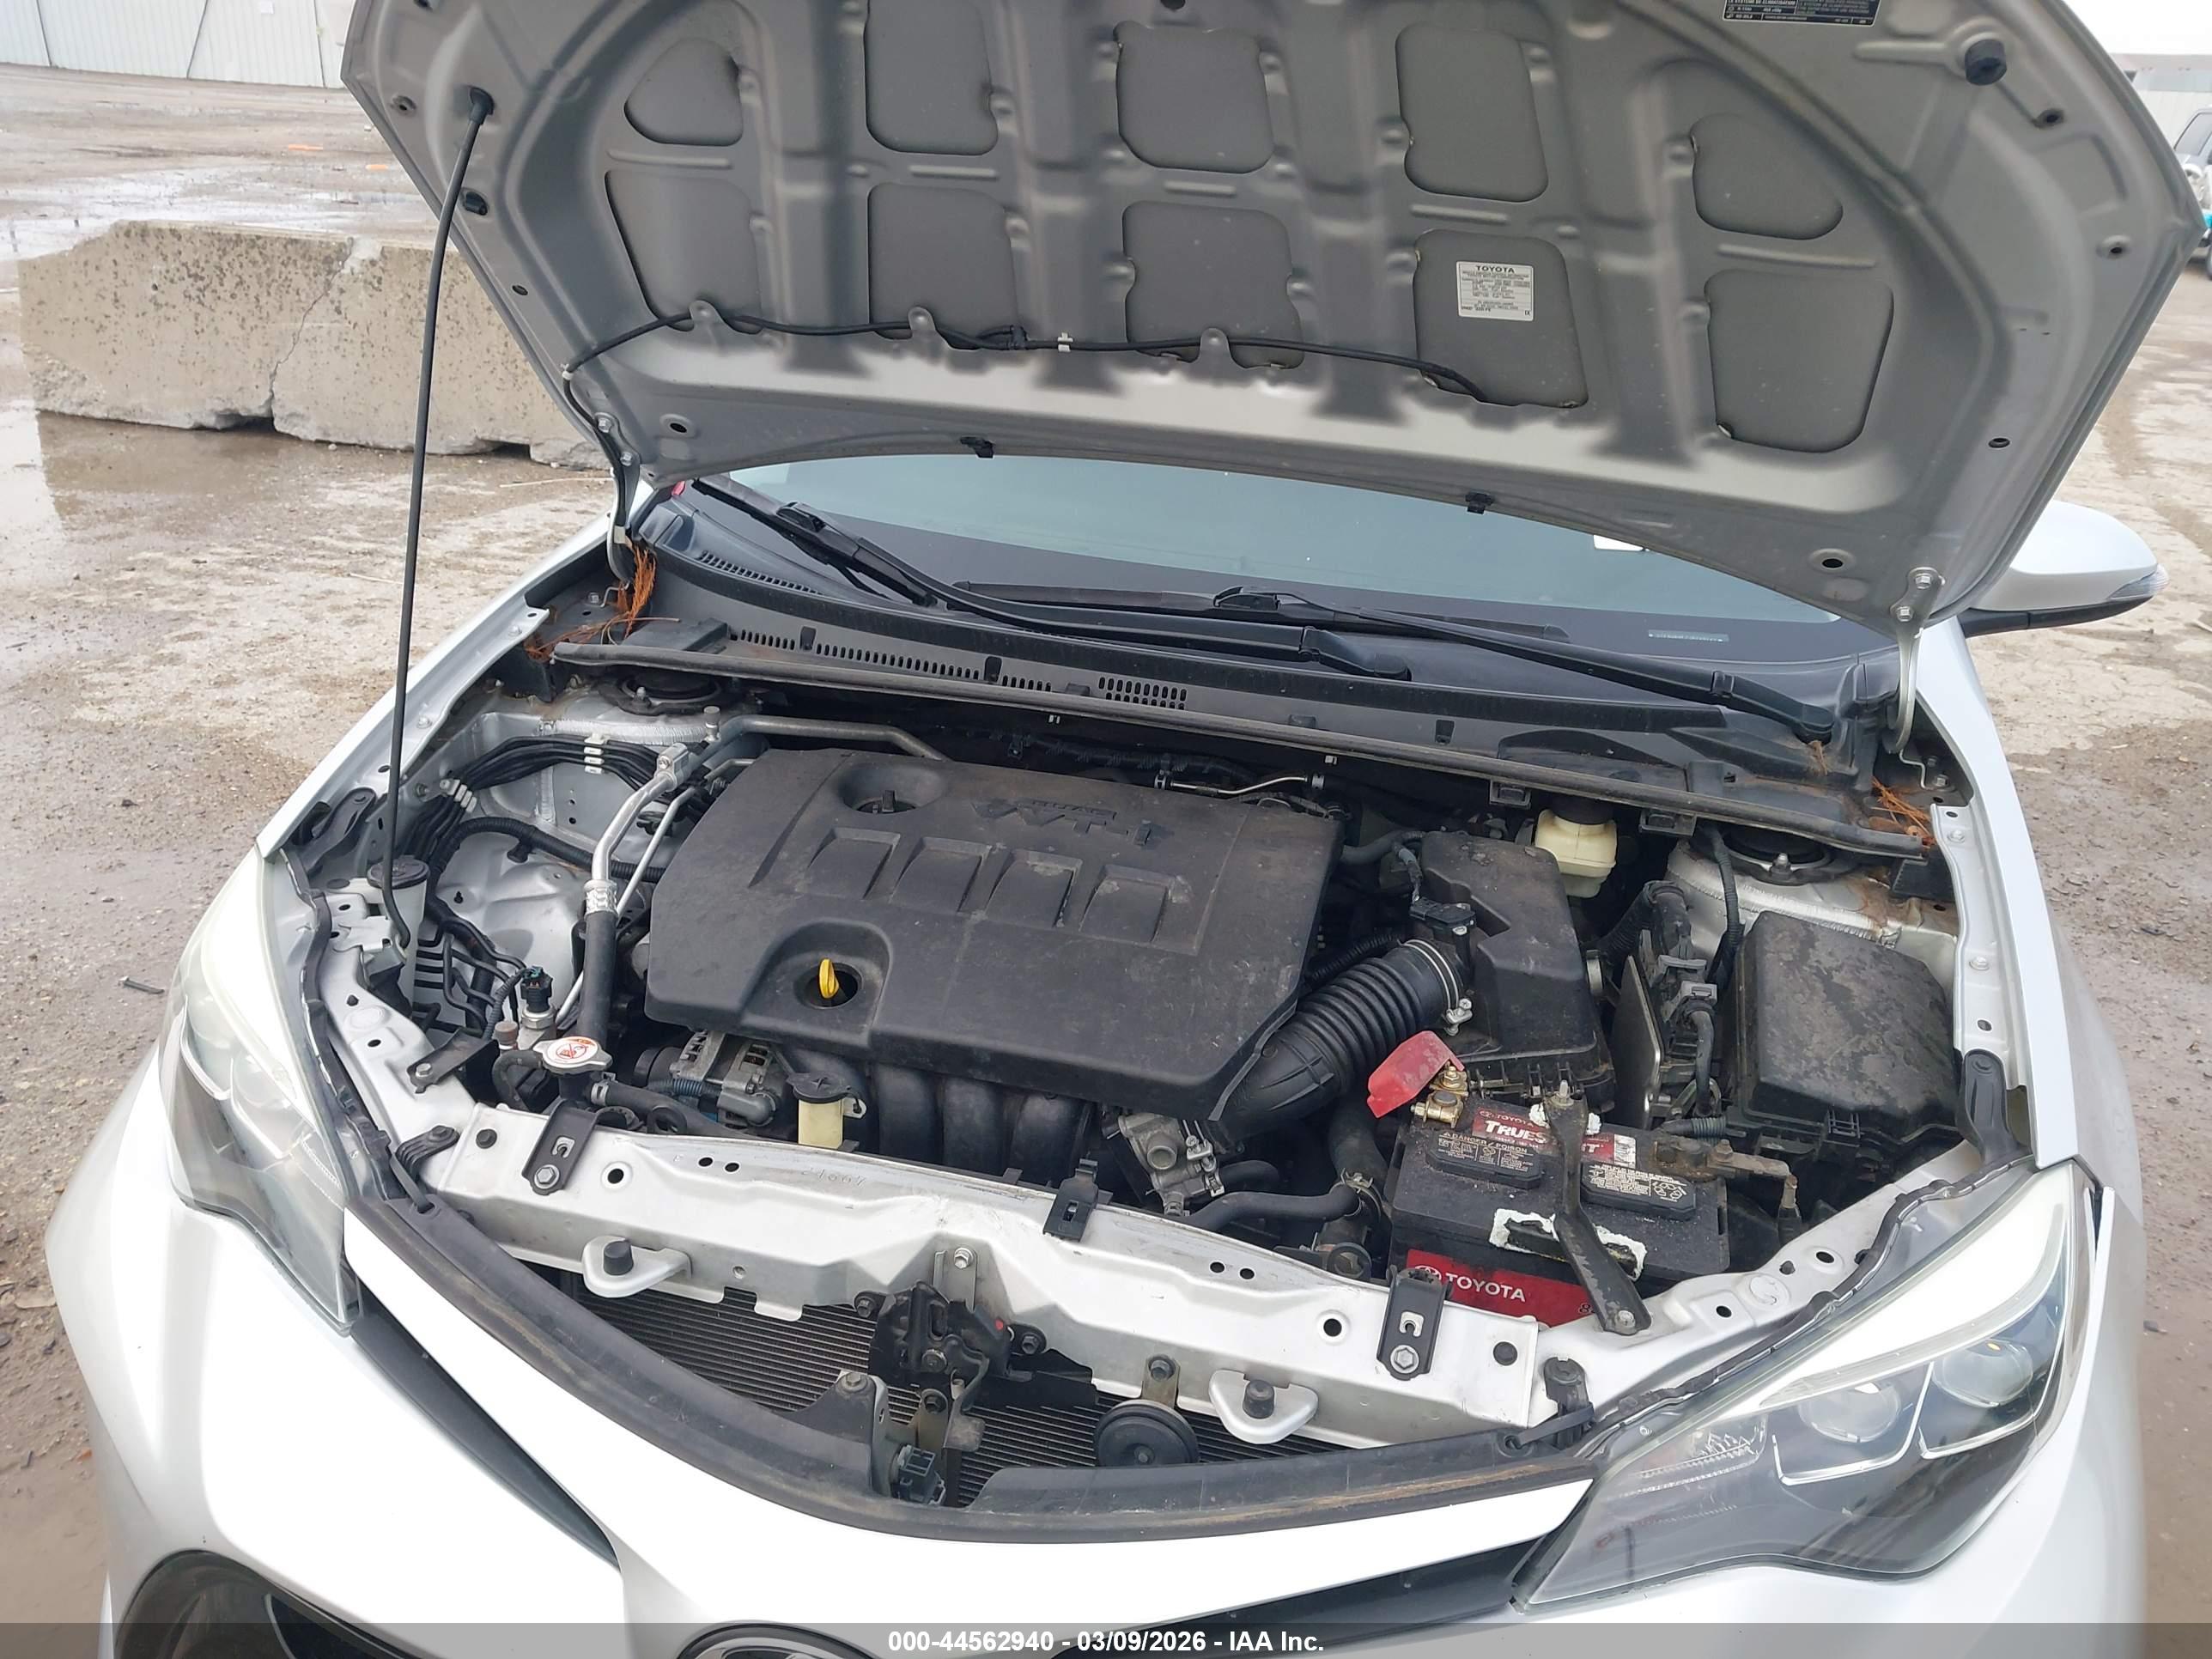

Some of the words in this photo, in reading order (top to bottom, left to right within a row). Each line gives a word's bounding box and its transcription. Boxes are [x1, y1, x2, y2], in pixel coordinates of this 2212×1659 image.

[1497, 1114, 1534, 1127] TOYOTA
[1452, 1133, 1487, 1145] DANGER
[1496, 1143, 1528, 1154] POISON
[1445, 1273, 1526, 1303] TOYOTA
